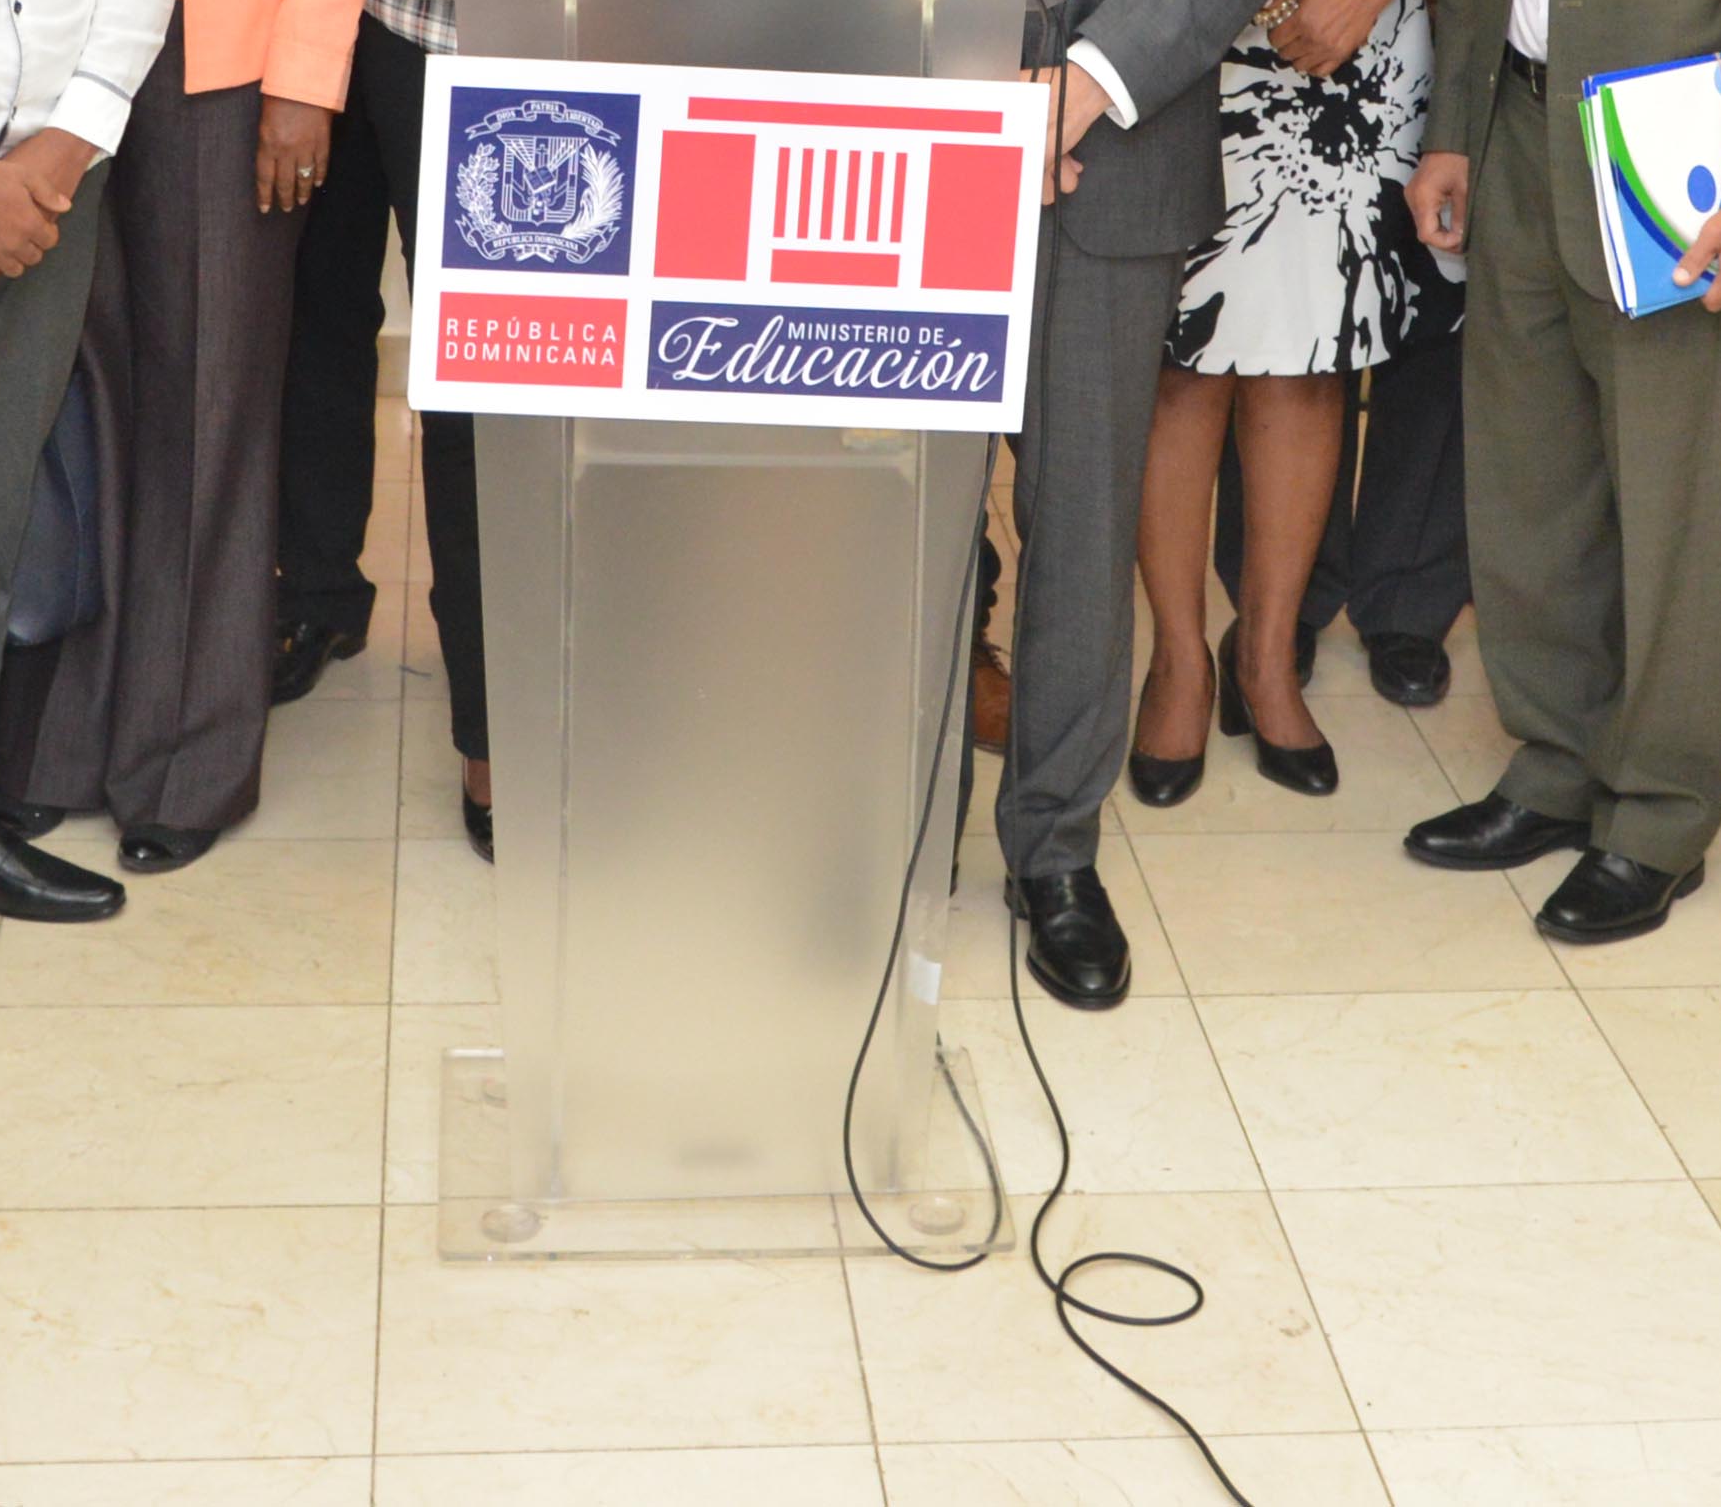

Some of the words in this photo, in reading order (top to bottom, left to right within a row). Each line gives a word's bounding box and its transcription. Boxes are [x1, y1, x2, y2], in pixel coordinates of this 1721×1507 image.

[530, 103, 559, 112] PATRIA
[446, 316, 617, 344] REPÚBLICA
[787, 321, 912, 345] MINISTERIO
[918, 326, 945, 345] DE
[445, 341, 617, 366] DOMINICANA
[658, 314, 999, 393] Educación
